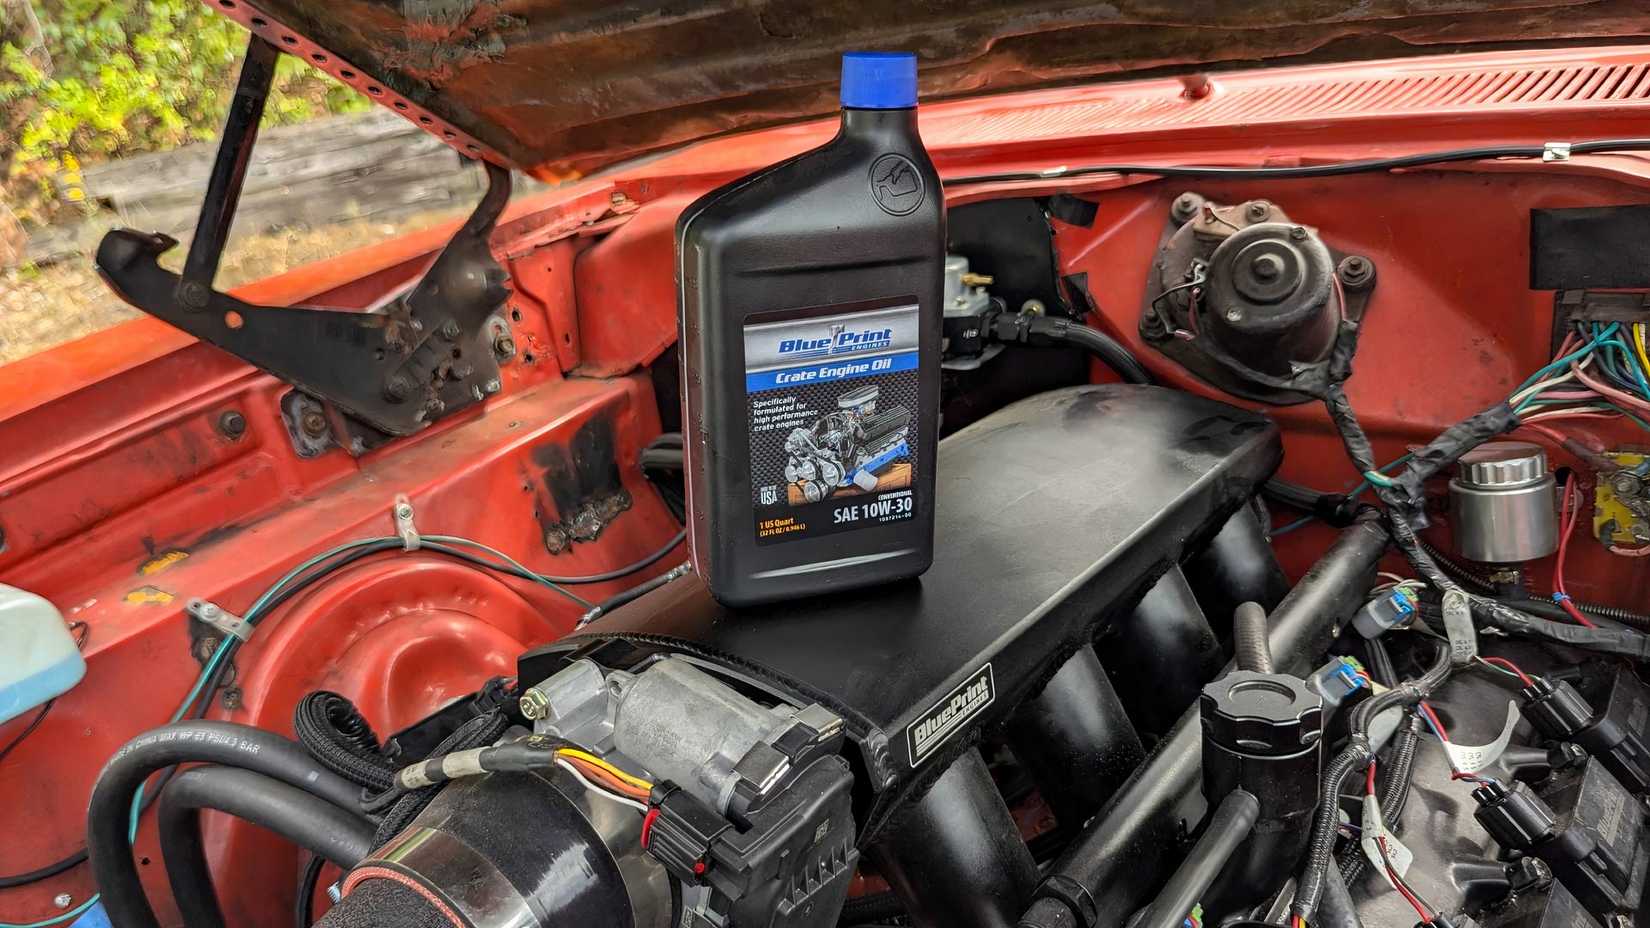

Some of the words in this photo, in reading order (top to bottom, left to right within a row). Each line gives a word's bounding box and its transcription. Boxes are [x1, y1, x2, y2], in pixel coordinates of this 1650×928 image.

[851, 340, 890, 350] ENGINES
[775, 370, 817, 384] Crate
[819, 362, 869, 378] Engine
[871, 358, 892, 371] Oil
[753, 396, 796, 408] Specifically
[753, 404, 795, 416] formulated
[797, 402, 807, 410] for
[753, 415, 770, 424] high
[771, 409, 818, 422] performance
[754, 423, 775, 432] crate
[775, 419, 804, 429] engines
[760, 490, 778, 505] USA
[833, 506, 859, 524] SAE
[862, 497, 913, 519] 10W-30
[760, 522, 764, 530] 1
[764, 520, 774, 529] US
[774, 518, 794, 527] Quart
[914, 675, 988, 746] BluePrint
[239, 740, 261, 753] BAR
